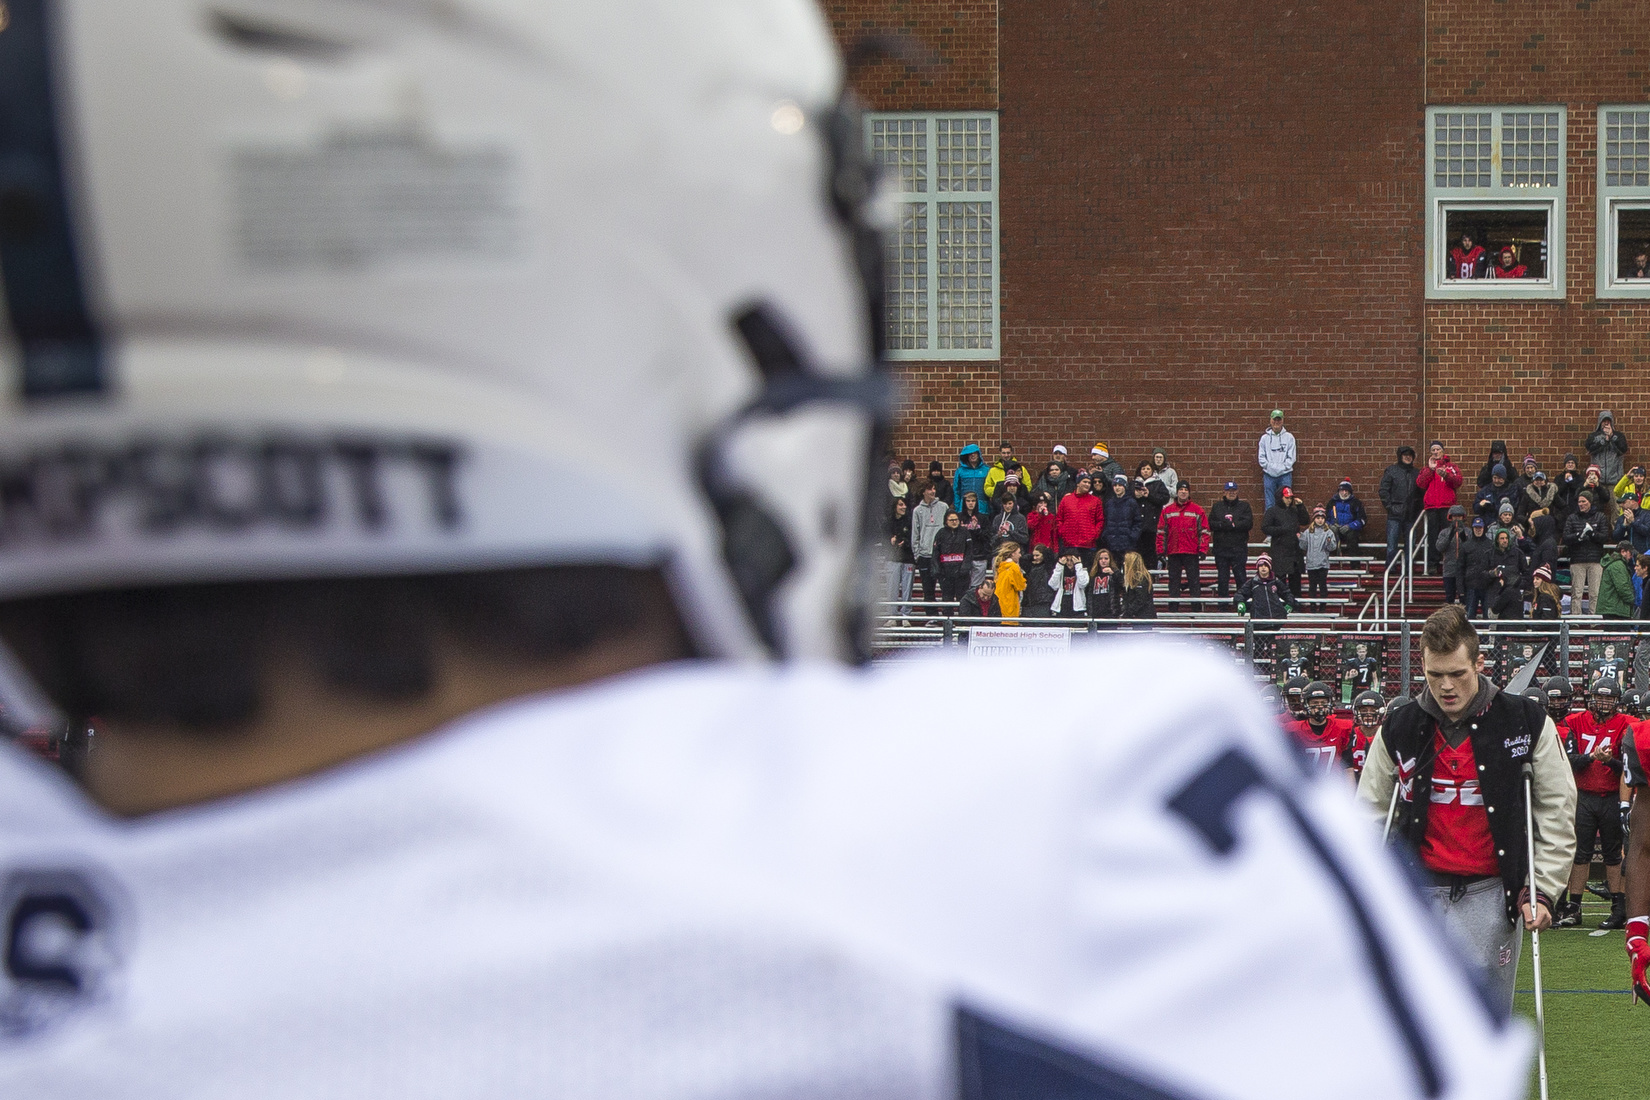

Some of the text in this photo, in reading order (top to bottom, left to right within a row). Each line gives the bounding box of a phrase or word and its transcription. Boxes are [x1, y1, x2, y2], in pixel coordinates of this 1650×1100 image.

[975, 631, 1064, 640] Marblehead High School
[1359, 668, 1368, 683] 7
[1600, 666, 1616, 679] 75
